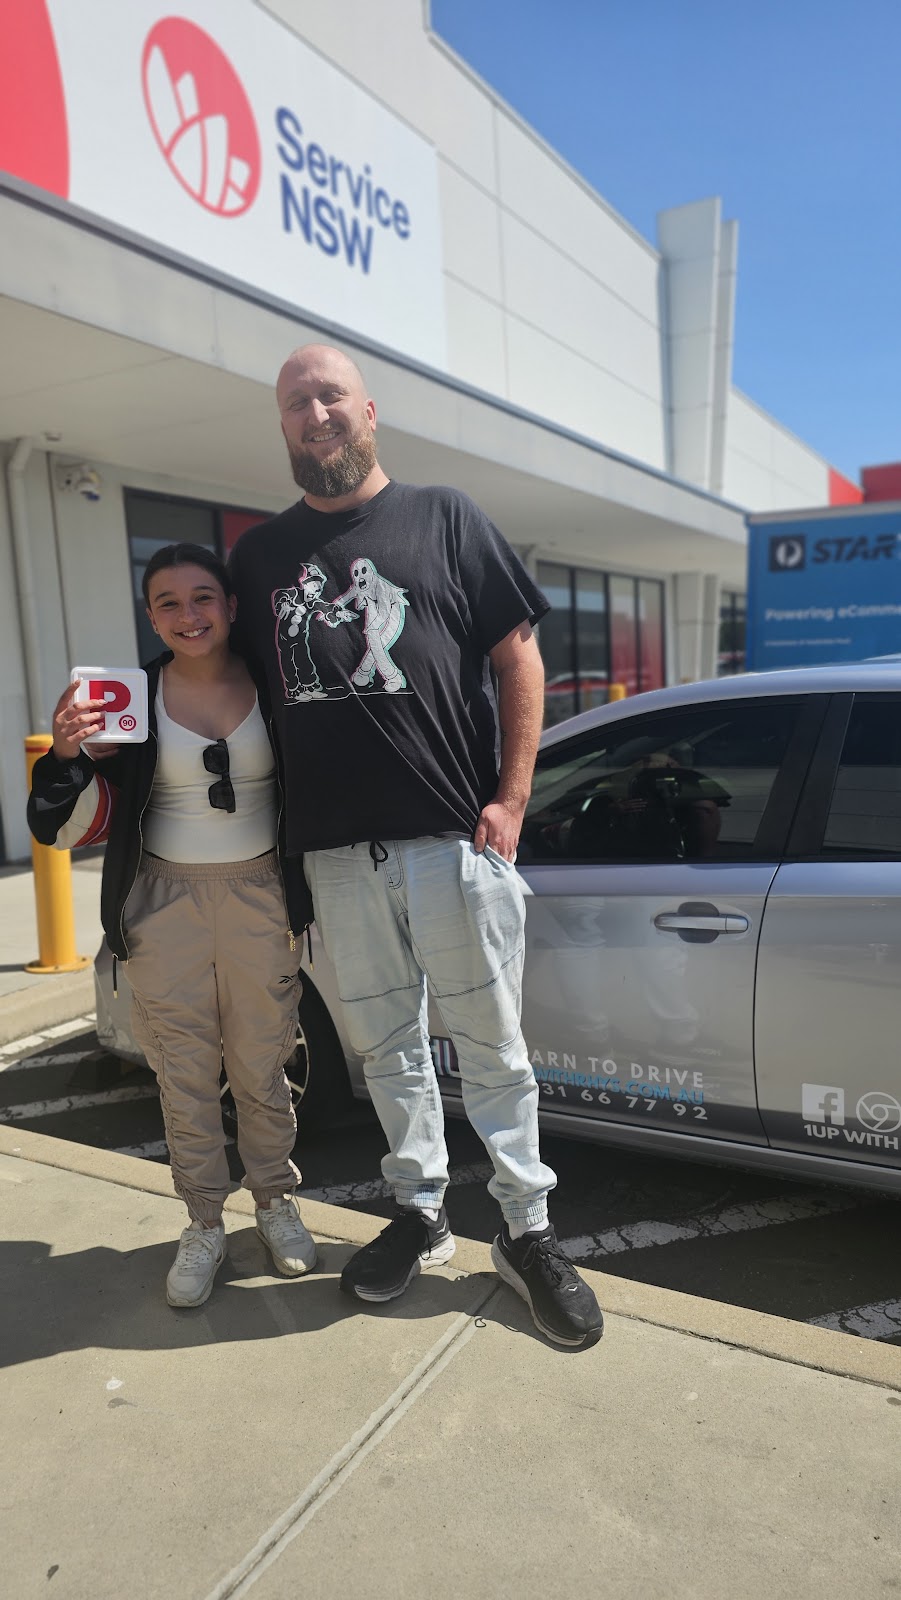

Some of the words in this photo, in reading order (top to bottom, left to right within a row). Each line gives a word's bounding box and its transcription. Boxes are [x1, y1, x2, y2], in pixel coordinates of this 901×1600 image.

[275, 105, 411, 240] Service
[280, 173, 374, 275] NSW
[812, 533, 901, 564] STAR
[764, 606, 834, 622] Powering
[89, 680, 131, 730] P
[122, 719, 133, 727] 90
[530, 1049, 577, 1070] ARN
[588, 1057, 618, 1075] TO
[630, 1062, 704, 1089] DRIVE
[580, 1089, 612, 1105] 66
[625, 1095, 657, 1112] 77
[672, 1103, 708, 1121] 92
[803, 1123, 840, 1140] 1UP
[842, 1129, 899, 1151] WITH
